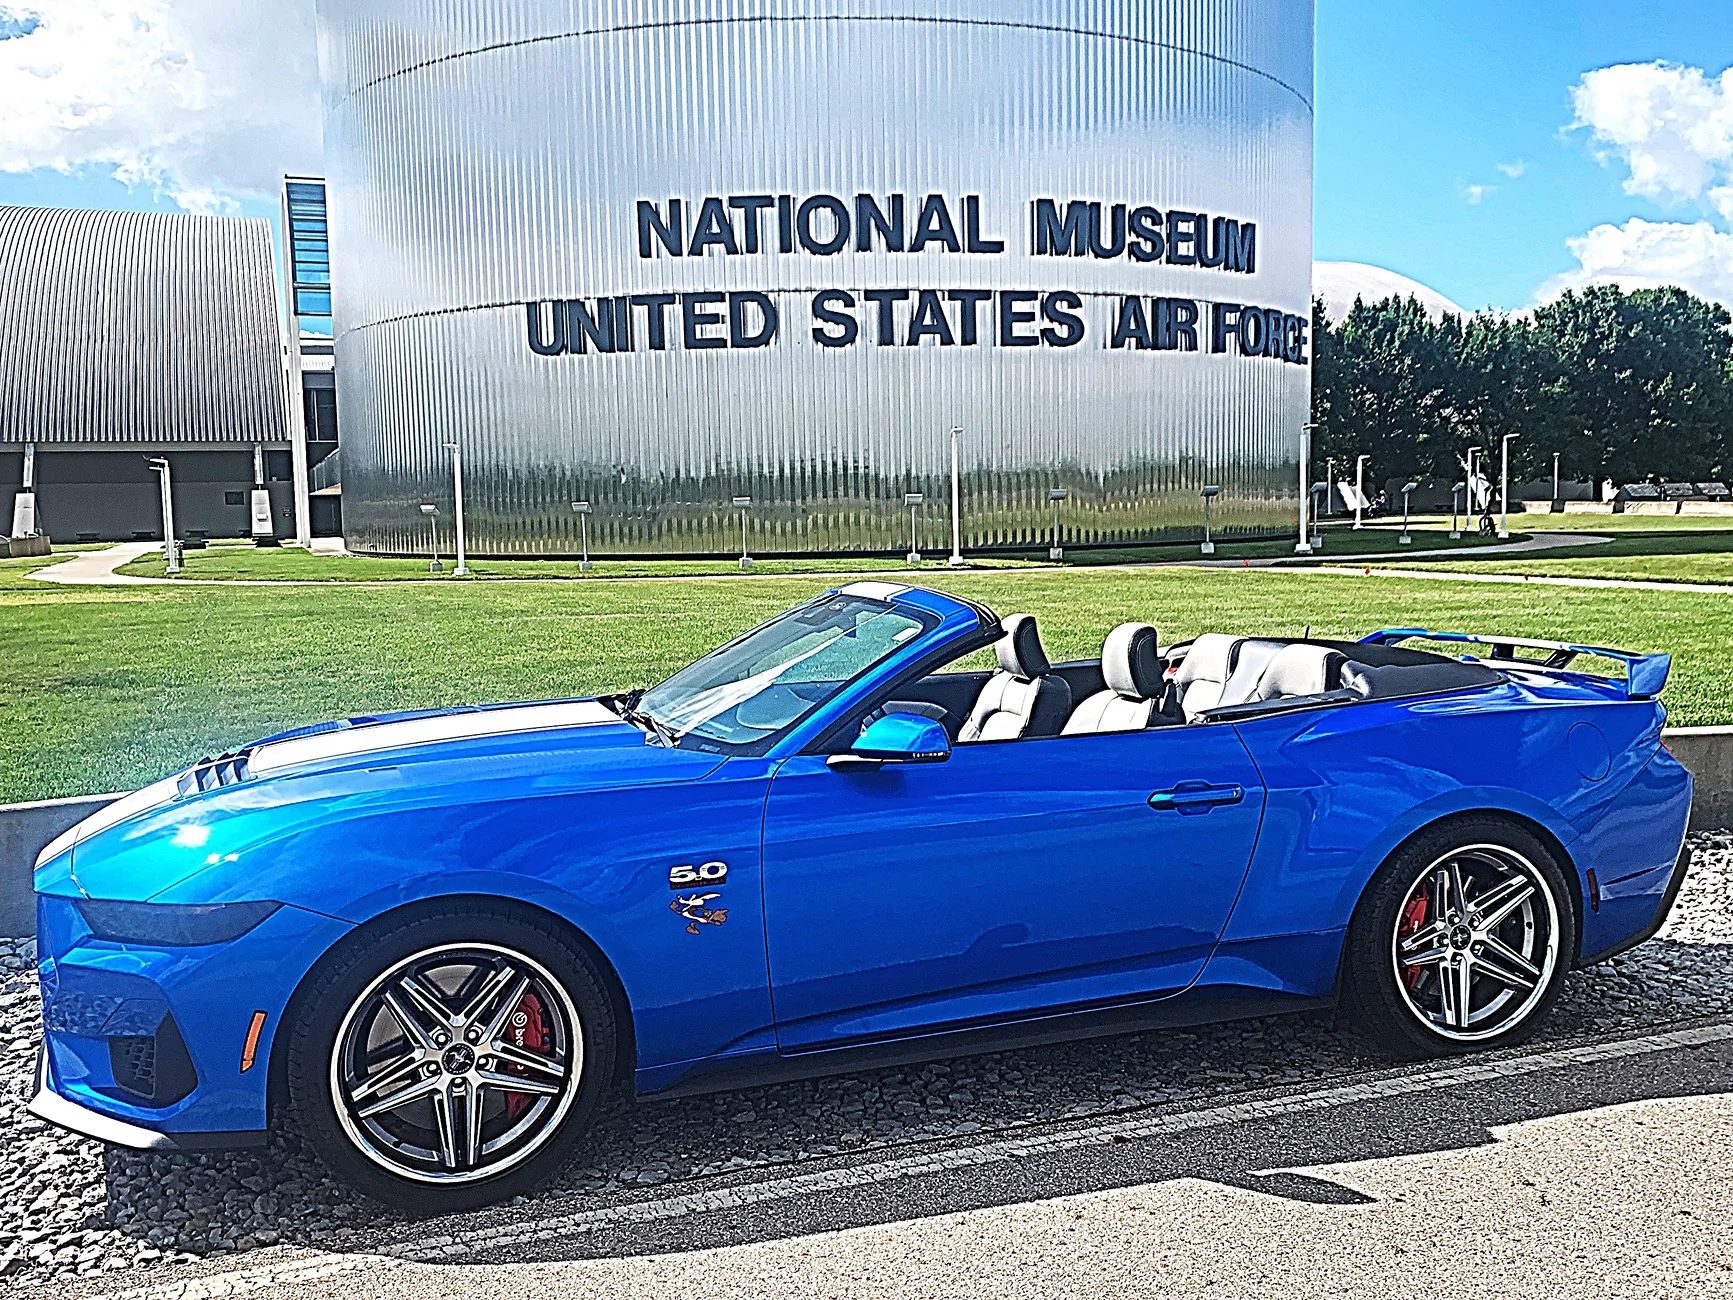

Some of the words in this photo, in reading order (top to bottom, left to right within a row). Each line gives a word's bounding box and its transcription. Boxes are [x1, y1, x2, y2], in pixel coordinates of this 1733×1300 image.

[636, 194, 1004, 258] NATIONAL
[1030, 199, 1256, 273] MUSEUM
[527, 290, 776, 356] UNITED
[811, 290, 1084, 350] STATES
[1110, 295, 1198, 353] AIR
[1211, 303, 1309, 365] FORCE
[669, 861, 728, 883] 5.0
